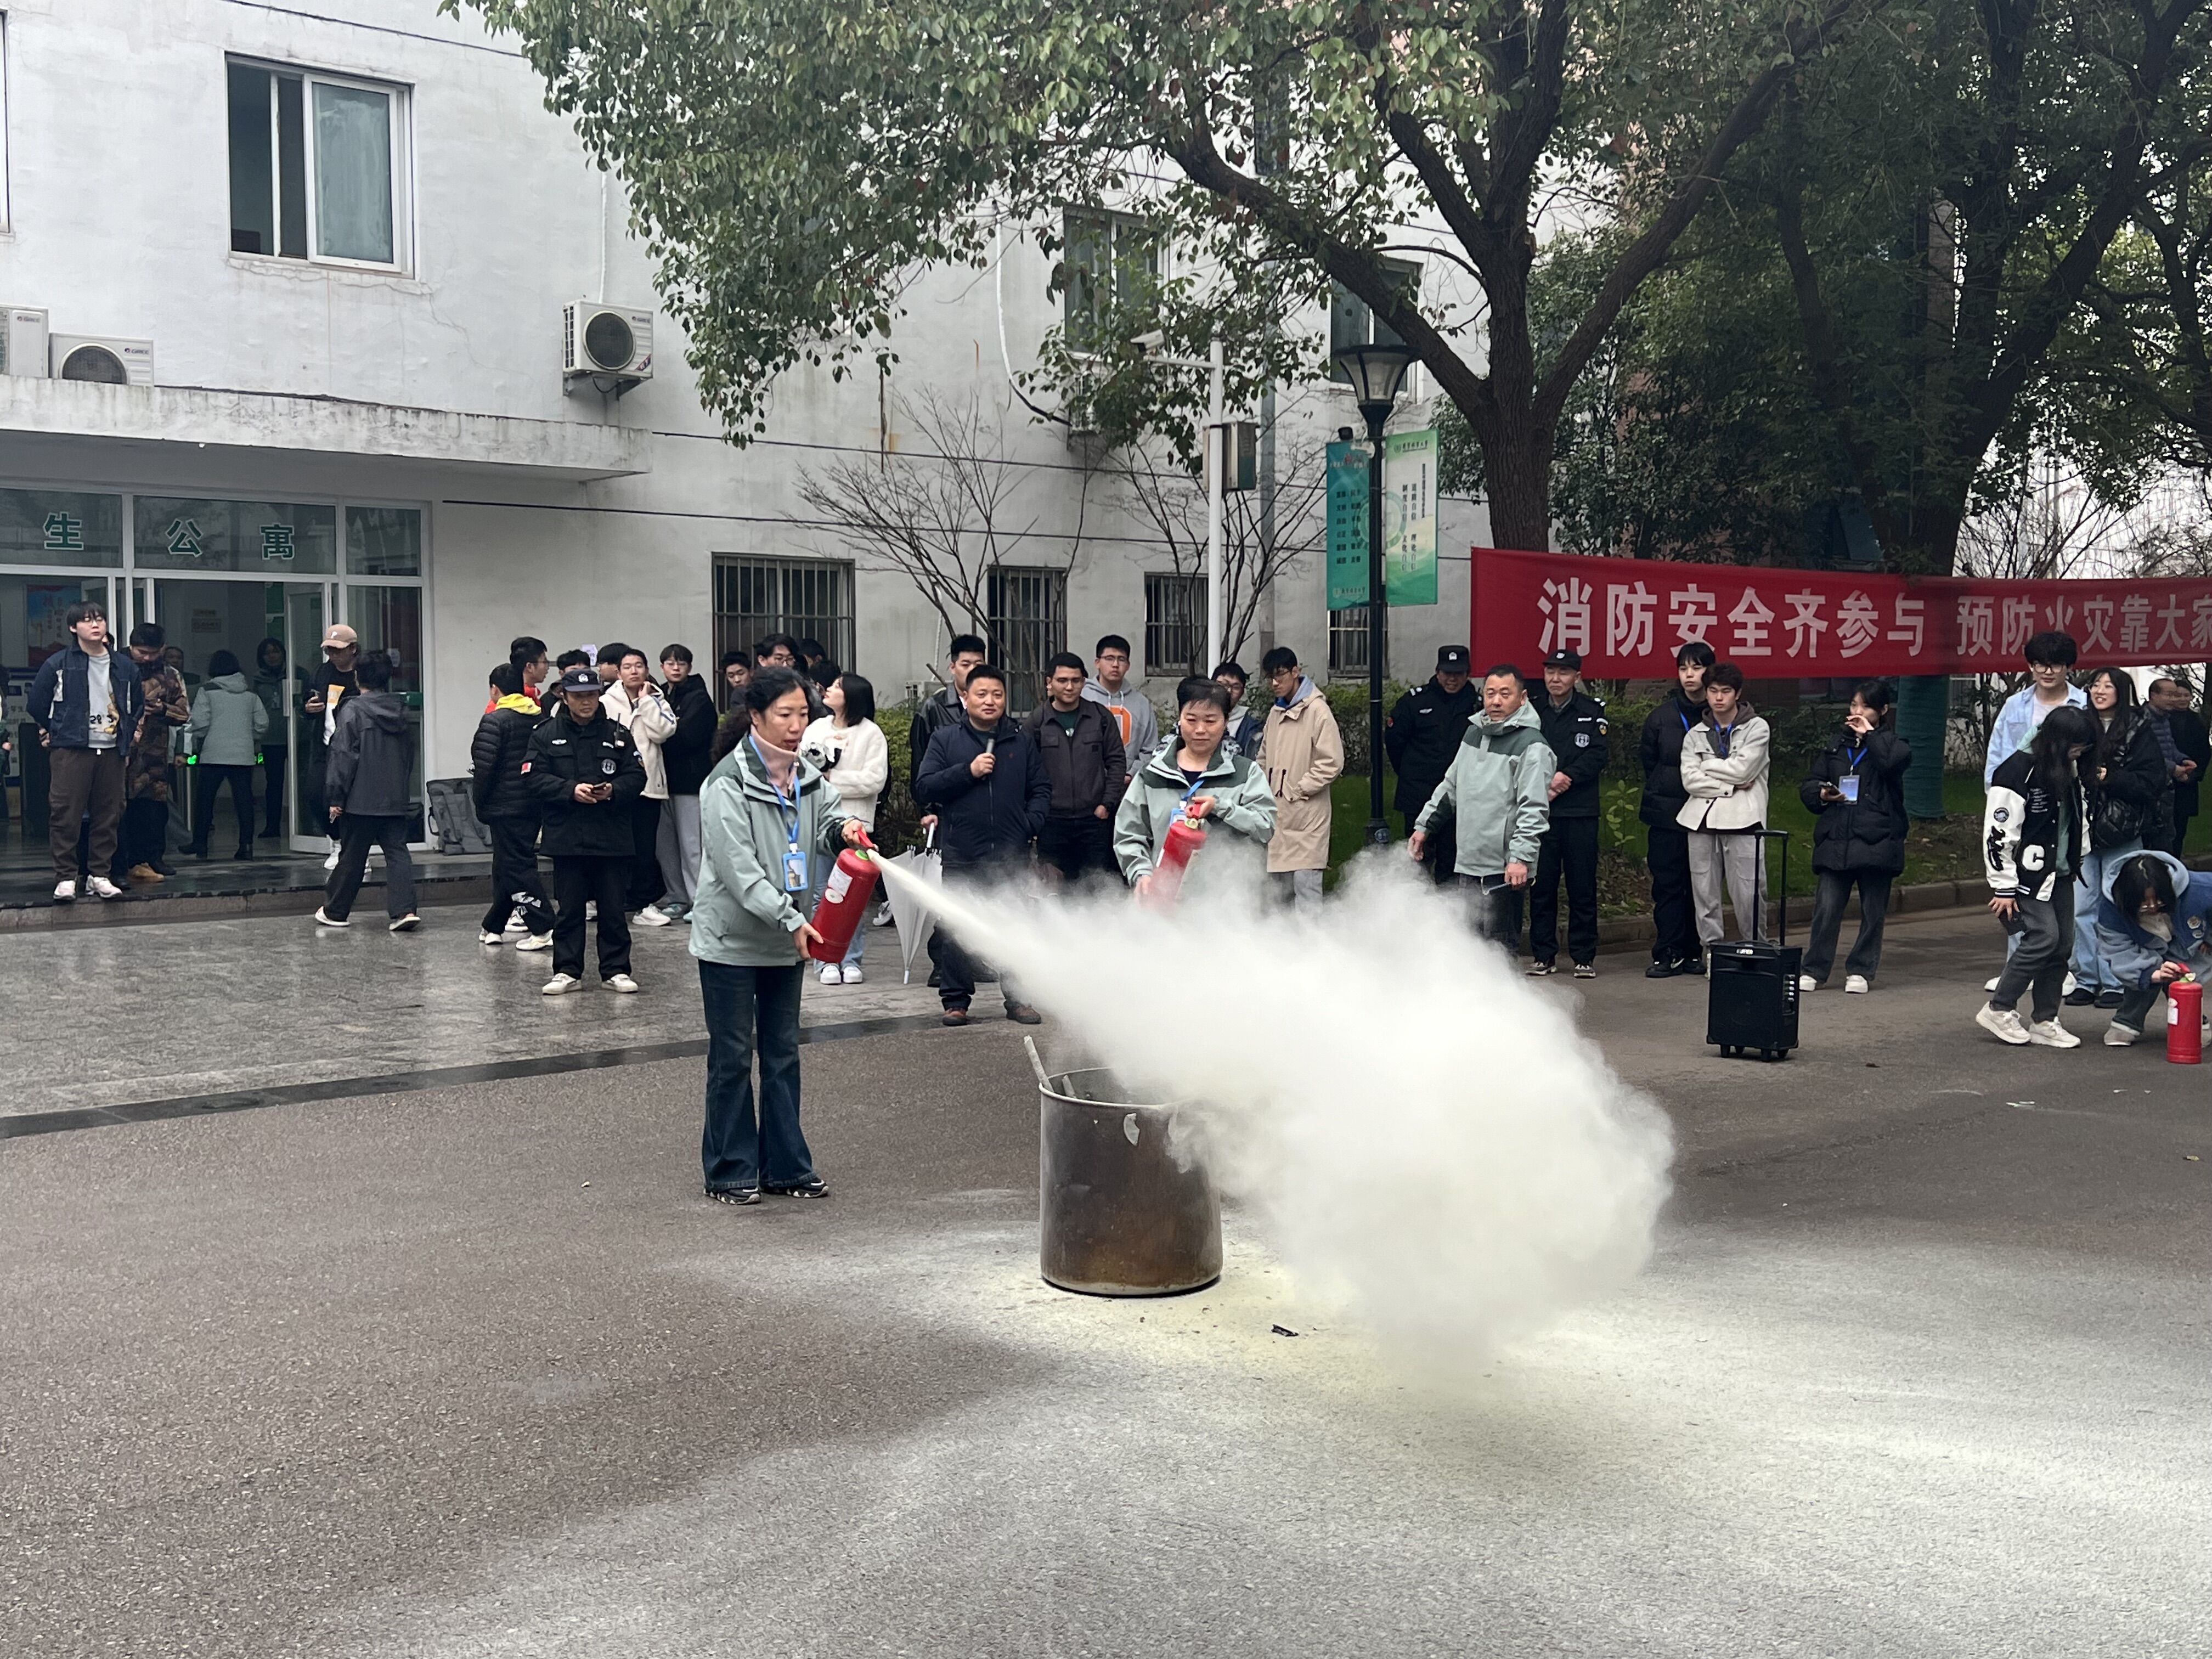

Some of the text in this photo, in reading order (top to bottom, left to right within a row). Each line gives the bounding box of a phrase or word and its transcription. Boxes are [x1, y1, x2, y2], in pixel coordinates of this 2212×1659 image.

[1537, 577, 1925, 658] 消防安全齐参与
[2022, 844, 2045, 871] C
